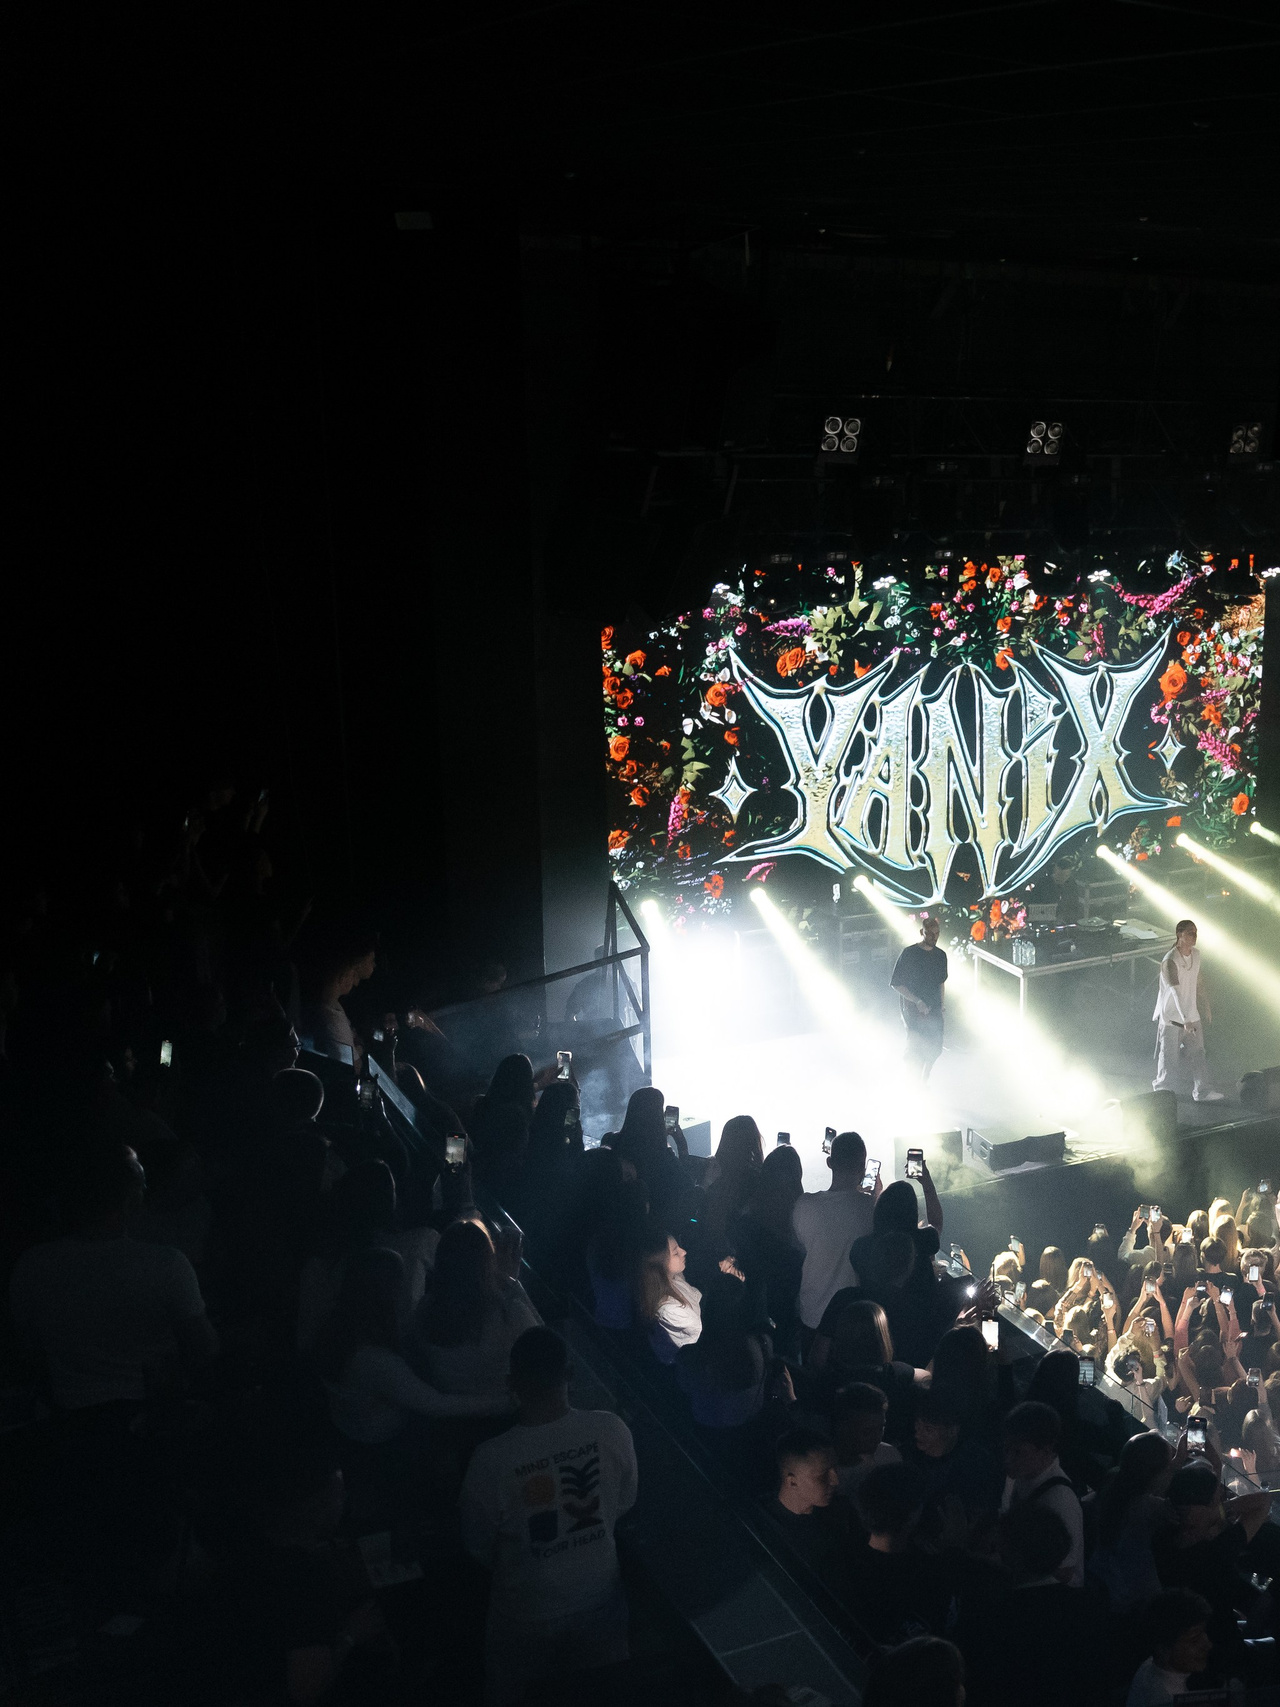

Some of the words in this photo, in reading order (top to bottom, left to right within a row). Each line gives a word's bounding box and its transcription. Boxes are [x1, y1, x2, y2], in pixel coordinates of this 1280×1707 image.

[514, 1457, 550, 1477] MIND
[553, 1440, 599, 1465] ESCAPE
[572, 1528, 606, 1548] HEAD
